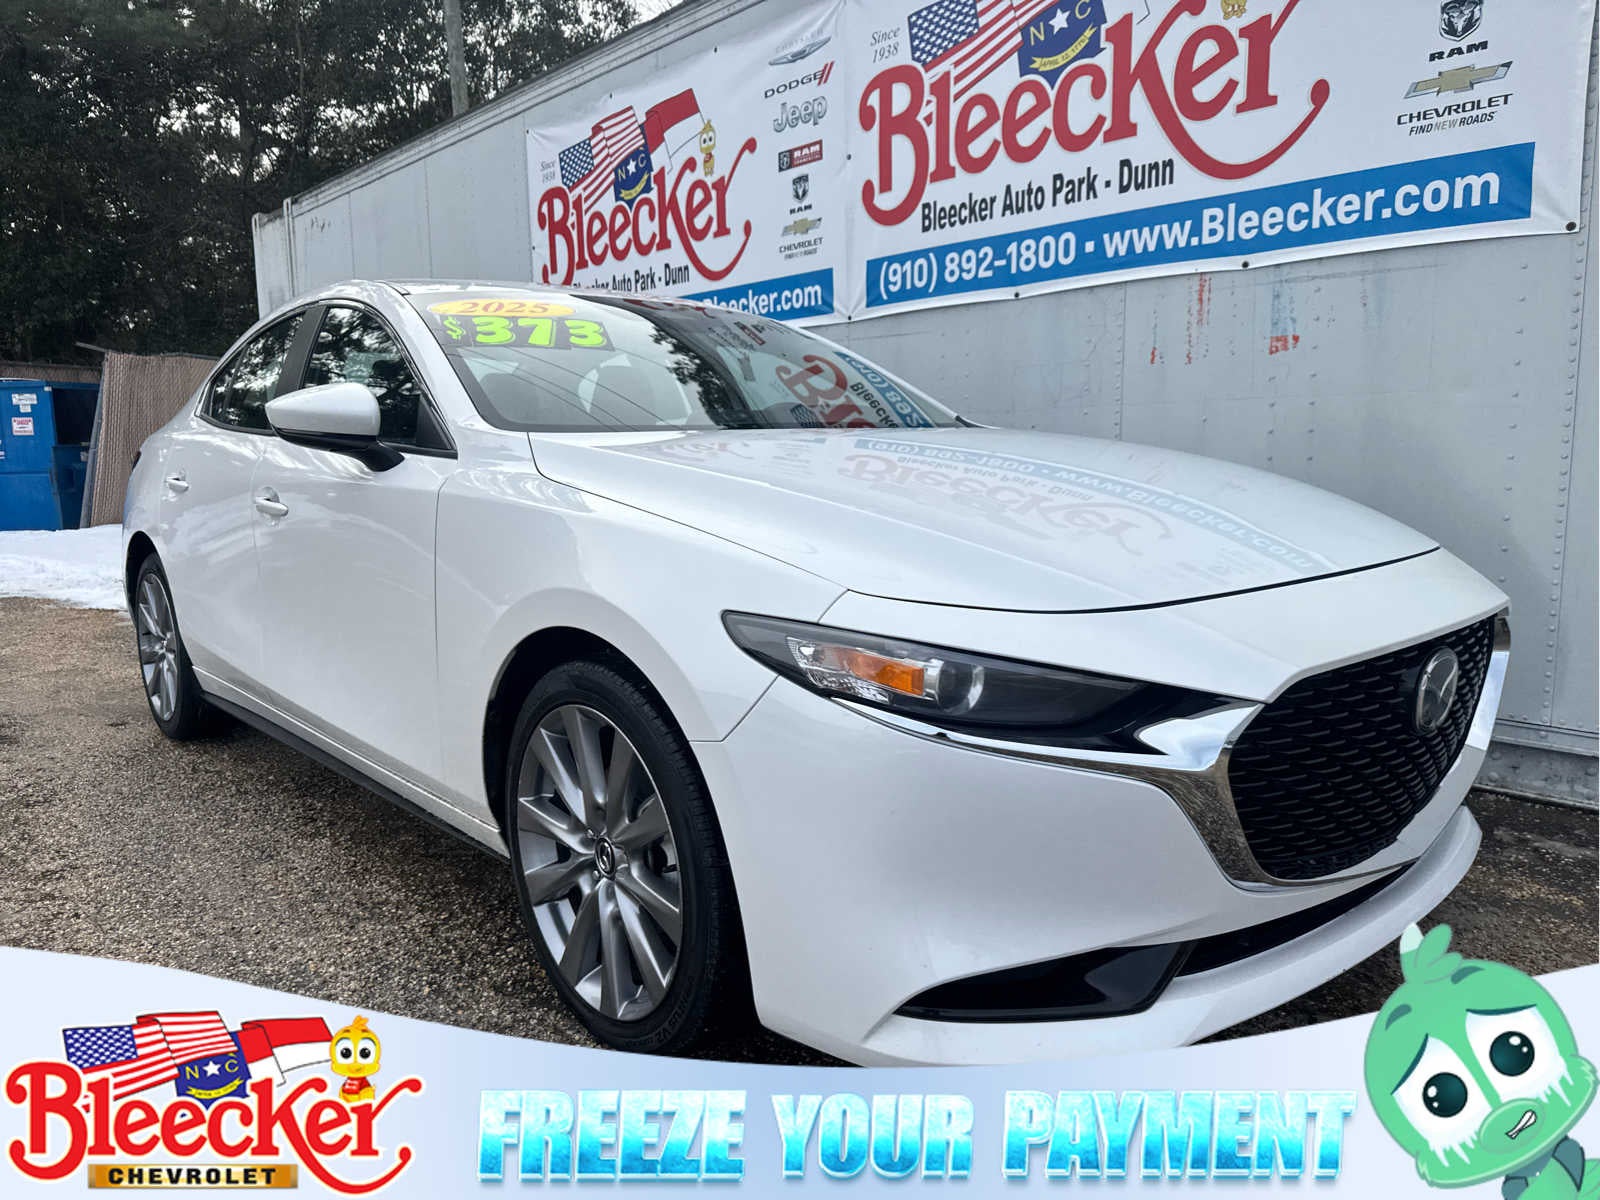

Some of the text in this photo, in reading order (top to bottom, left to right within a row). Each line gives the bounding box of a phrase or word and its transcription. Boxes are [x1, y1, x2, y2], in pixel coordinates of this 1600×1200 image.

[870, 25, 900, 48] Since
[1029, 21, 1045, 46] N
[871, 42, 900, 65] 1938
[1428, 40, 1488, 62] RAM
[764, 69, 826, 99] DODGE
[773, 95, 828, 133] Jeep
[858, 0, 1330, 226] Bleecker
[1397, 93, 1513, 126] CHEVROLET
[921, 191, 997, 234] Bleecker
[1001, 184, 1045, 218] Auto
[1052, 166, 1099, 208] Park
[1118, 158, 1175, 194] Dunn
[537, 137, 757, 286] Bleecker
[778, 237, 824, 254] CHEVROLET
[879, 171, 1501, 300] (910) 892-1800 www.Bleecker.com
[611, 273, 632, 292] Auto
[634, 267, 656, 292] Park
[664, 262, 690, 286] Dunn
[459, 301, 550, 315] 2025
